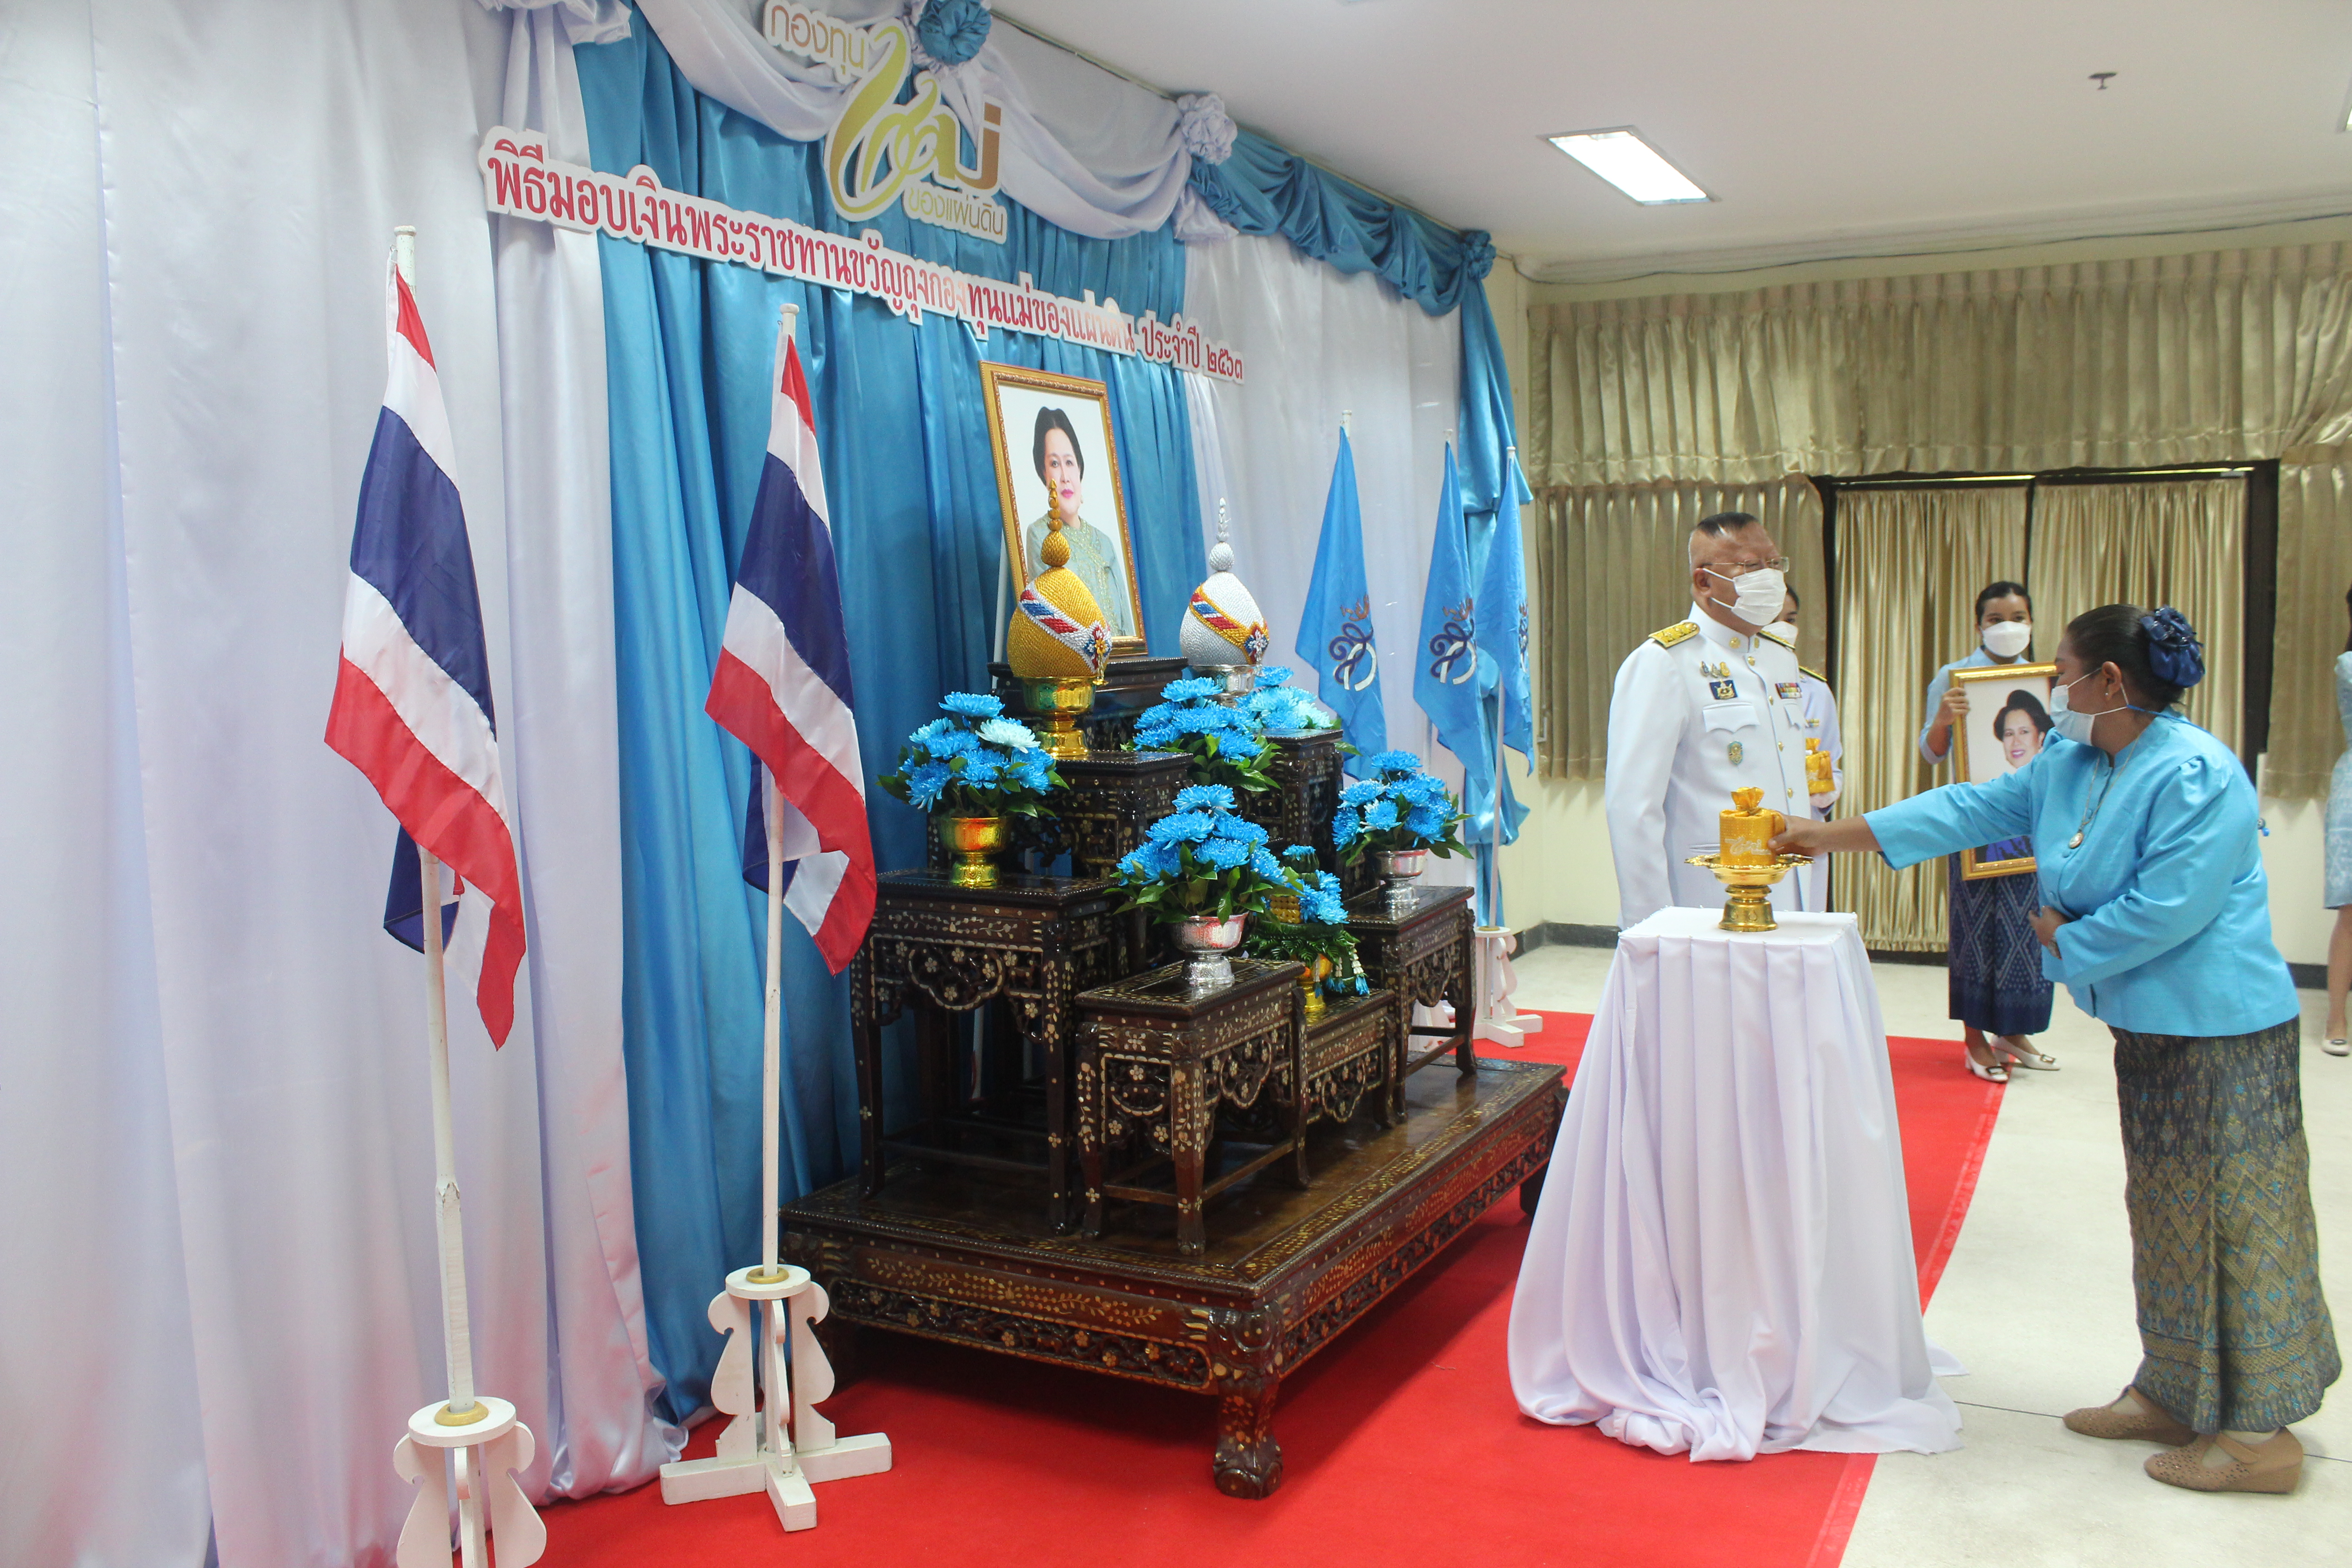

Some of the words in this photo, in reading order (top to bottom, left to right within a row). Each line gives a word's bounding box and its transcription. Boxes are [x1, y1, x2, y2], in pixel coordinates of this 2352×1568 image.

[772, 5, 865, 75] กองทุน
[829, 26, 1001, 213] แม่
[909, 187, 1004, 236] ของแผ่นดิน
[1142, 319, 1200, 368] ประจำปี
[1206, 343, 1243, 380] ๒๕๖๓
